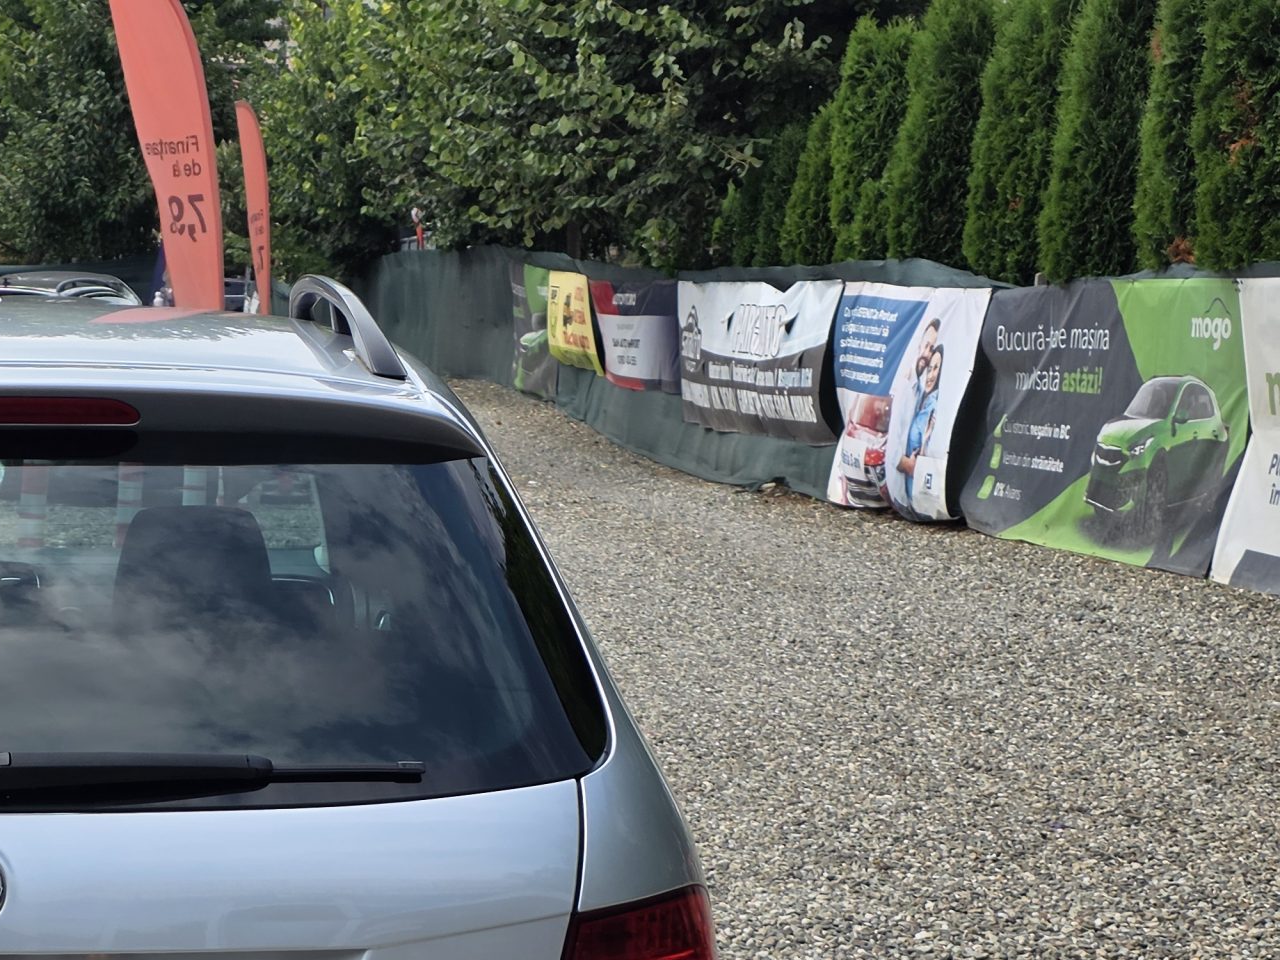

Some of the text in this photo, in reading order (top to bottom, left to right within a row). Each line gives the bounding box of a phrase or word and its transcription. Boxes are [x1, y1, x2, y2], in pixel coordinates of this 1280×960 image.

[1069, 321, 1110, 357] mașina
[1191, 316, 1232, 350] mogo
[1062, 366, 1103, 394] astăzi!
